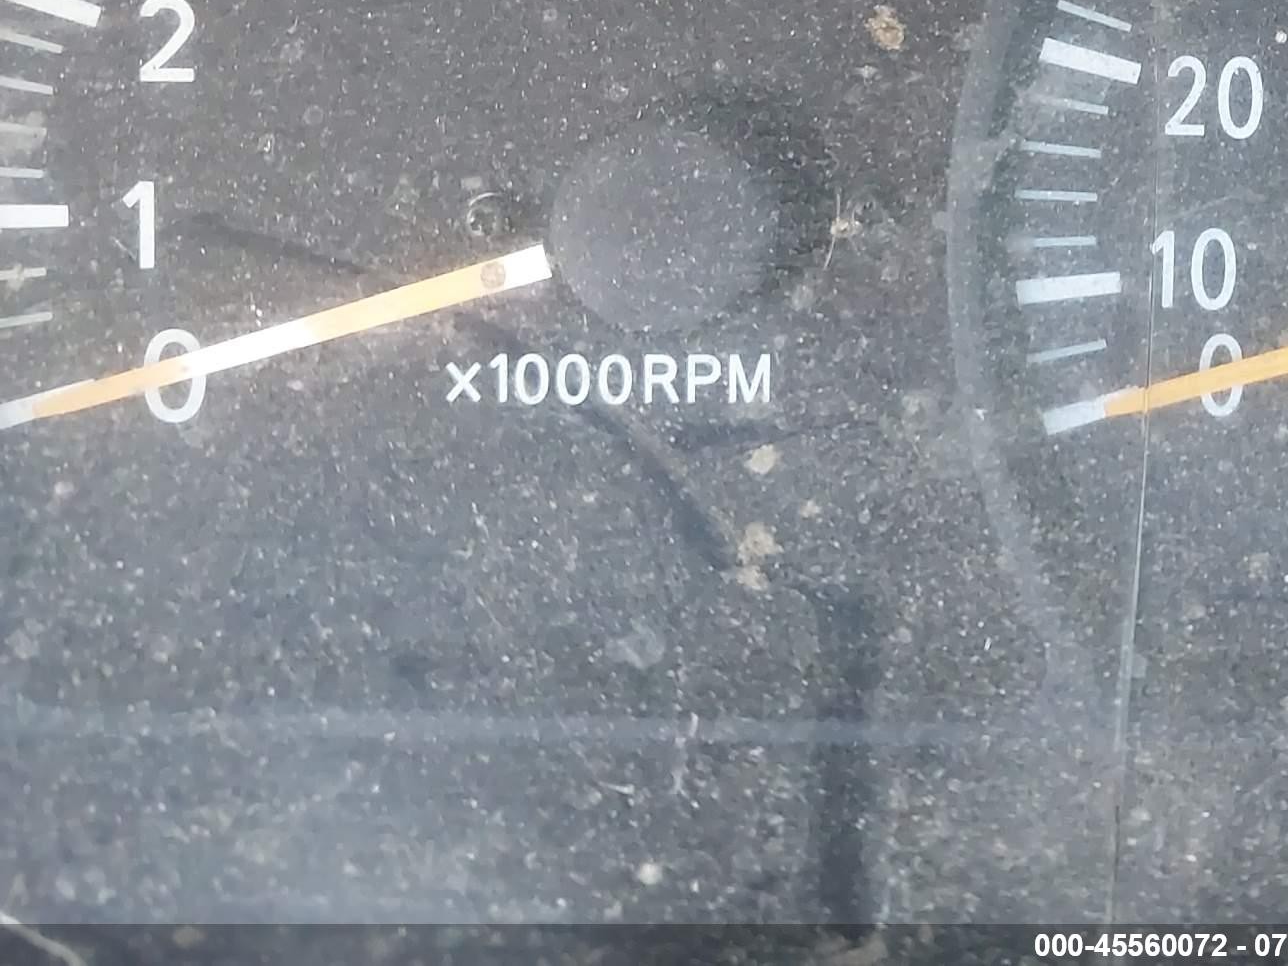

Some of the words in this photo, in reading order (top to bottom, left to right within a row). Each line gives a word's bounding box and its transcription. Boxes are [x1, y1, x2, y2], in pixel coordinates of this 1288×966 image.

[1163, 54, 1265, 142] 20
[121, 180, 156, 269] 1
[1150, 226, 1238, 314] 10
[142, 328, 207, 424] 0
[1198, 333, 1245, 418] 0
